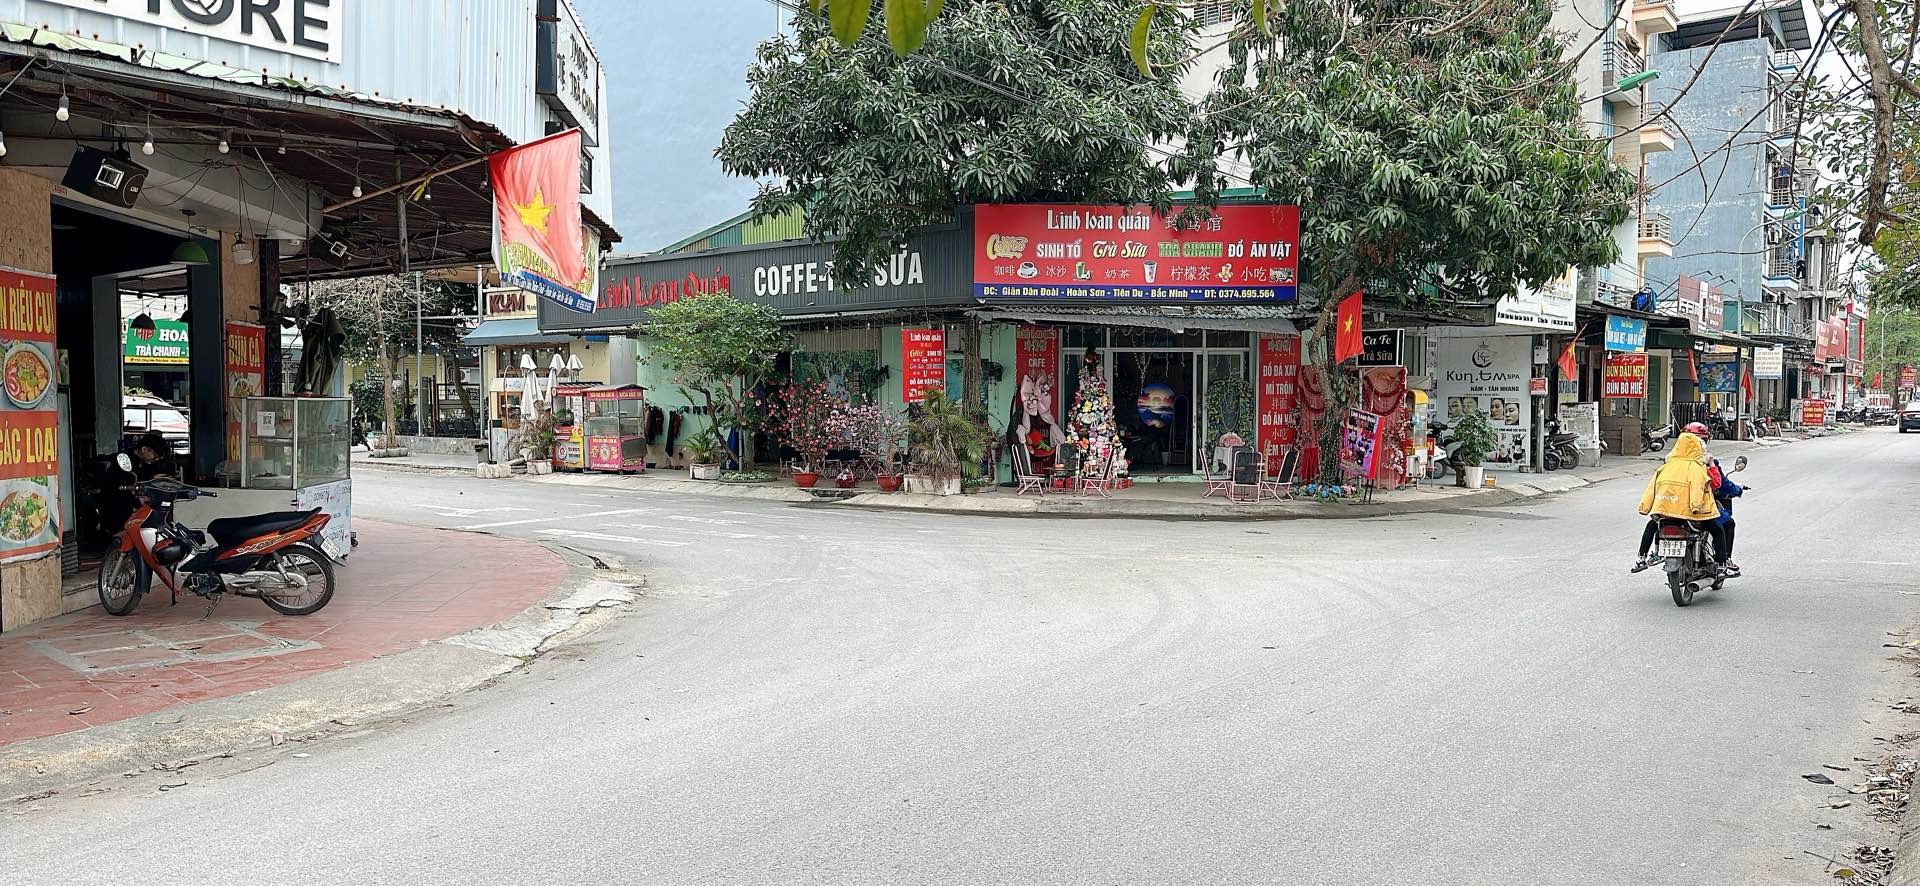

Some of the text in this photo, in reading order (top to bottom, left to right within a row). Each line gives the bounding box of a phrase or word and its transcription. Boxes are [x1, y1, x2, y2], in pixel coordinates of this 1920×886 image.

[1047, 209, 1150, 233] Linh loan quán
[1037, 243, 1064, 258] SINH
[1066, 238, 1082, 258] TỐ
[1093, 240, 1117, 258] Trà
[1121, 239, 1148, 259] Sữa
[1158, 239, 1180, 257] TRÀ
[1183, 241, 1223, 257] CHANH
[1250, 240, 1267, 258] ĂN
[1270, 240, 1292, 260] VẶT
[994, 264, 1015, 277] 咖啡
[1046, 265, 1067, 278] 冰沙
[1104, 268, 1131, 280] 奶茶
[1170, 265, 1211, 281] 柠檬茶
[1240, 266, 1267, 282] 小吃
[634, 274, 679, 307] Loan
[1066, 287, 1088, 297] Hoàn
[1132, 288, 1143, 298] Du
[1169, 289, 1188, 298] Ninh
[1218, 289, 1275, 299] 0374.695.564
[136, 344, 181, 358] TRÀ CHANH
[1028, 358, 1046, 368] CAFE
